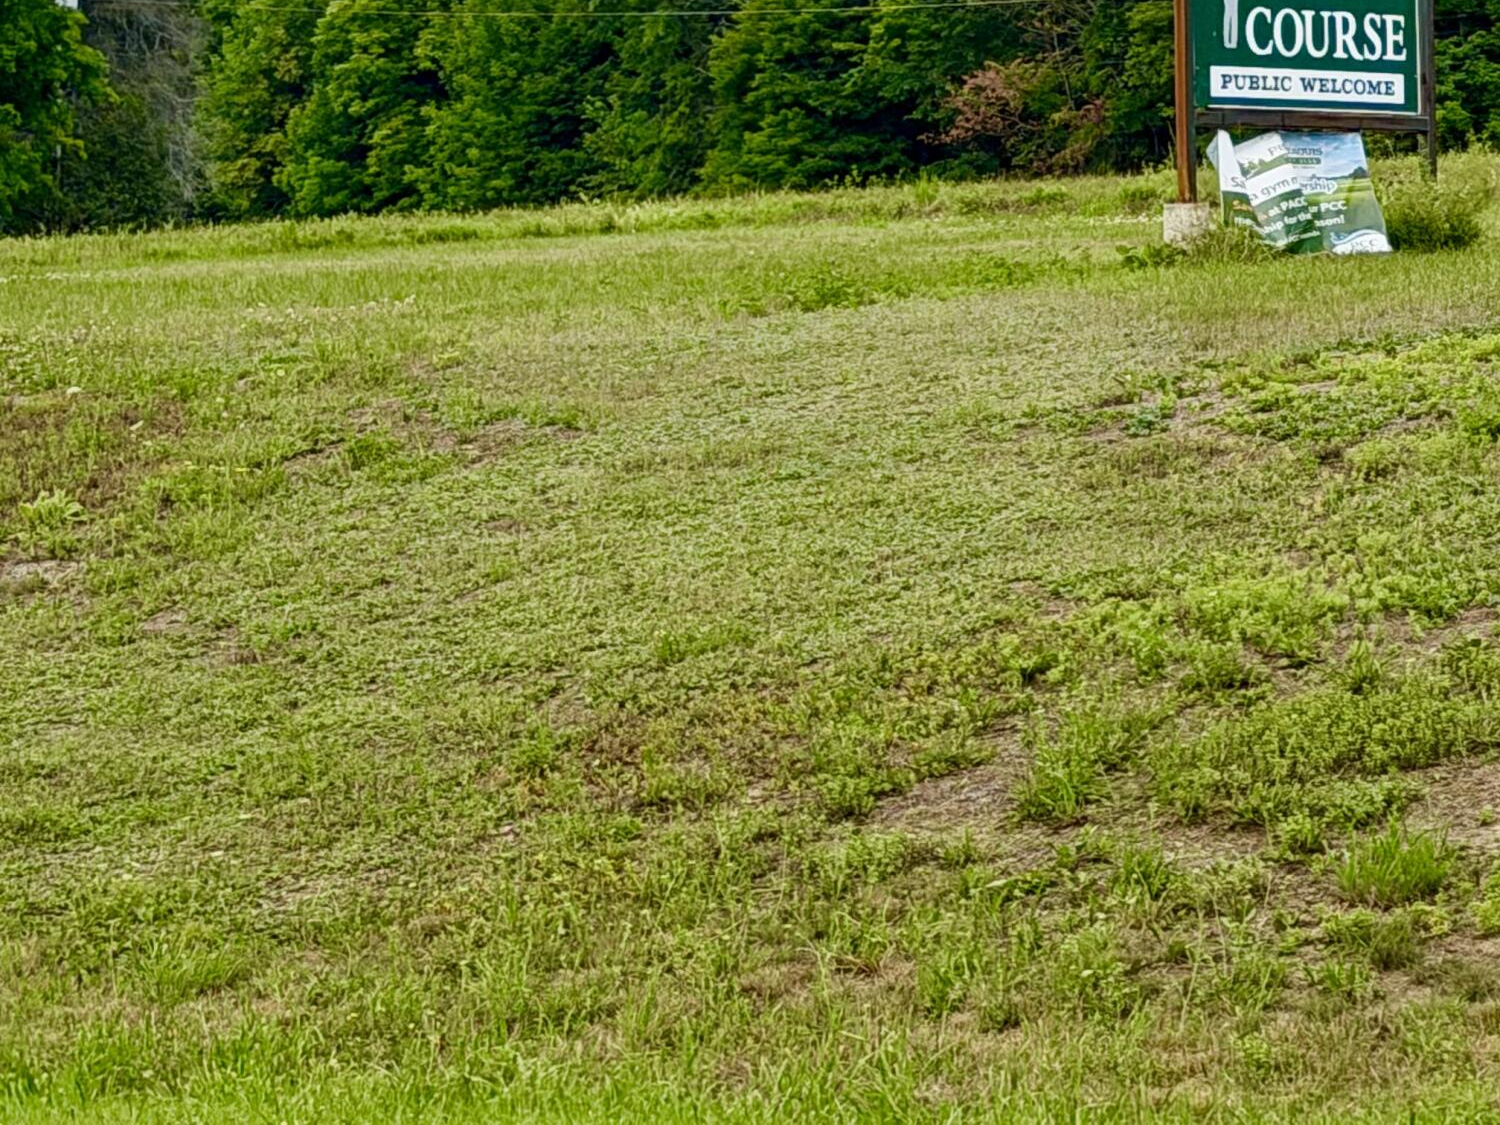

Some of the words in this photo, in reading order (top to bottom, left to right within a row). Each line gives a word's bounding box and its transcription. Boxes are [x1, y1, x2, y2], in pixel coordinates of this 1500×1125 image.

[1245, 6, 1407, 62] COURSE
[1220, 73, 1292, 92] PUBLIC
[1299, 76, 1395, 96] WELCOME
[1261, 178, 1290, 197] gym
[1320, 200, 1348, 213] PCC
